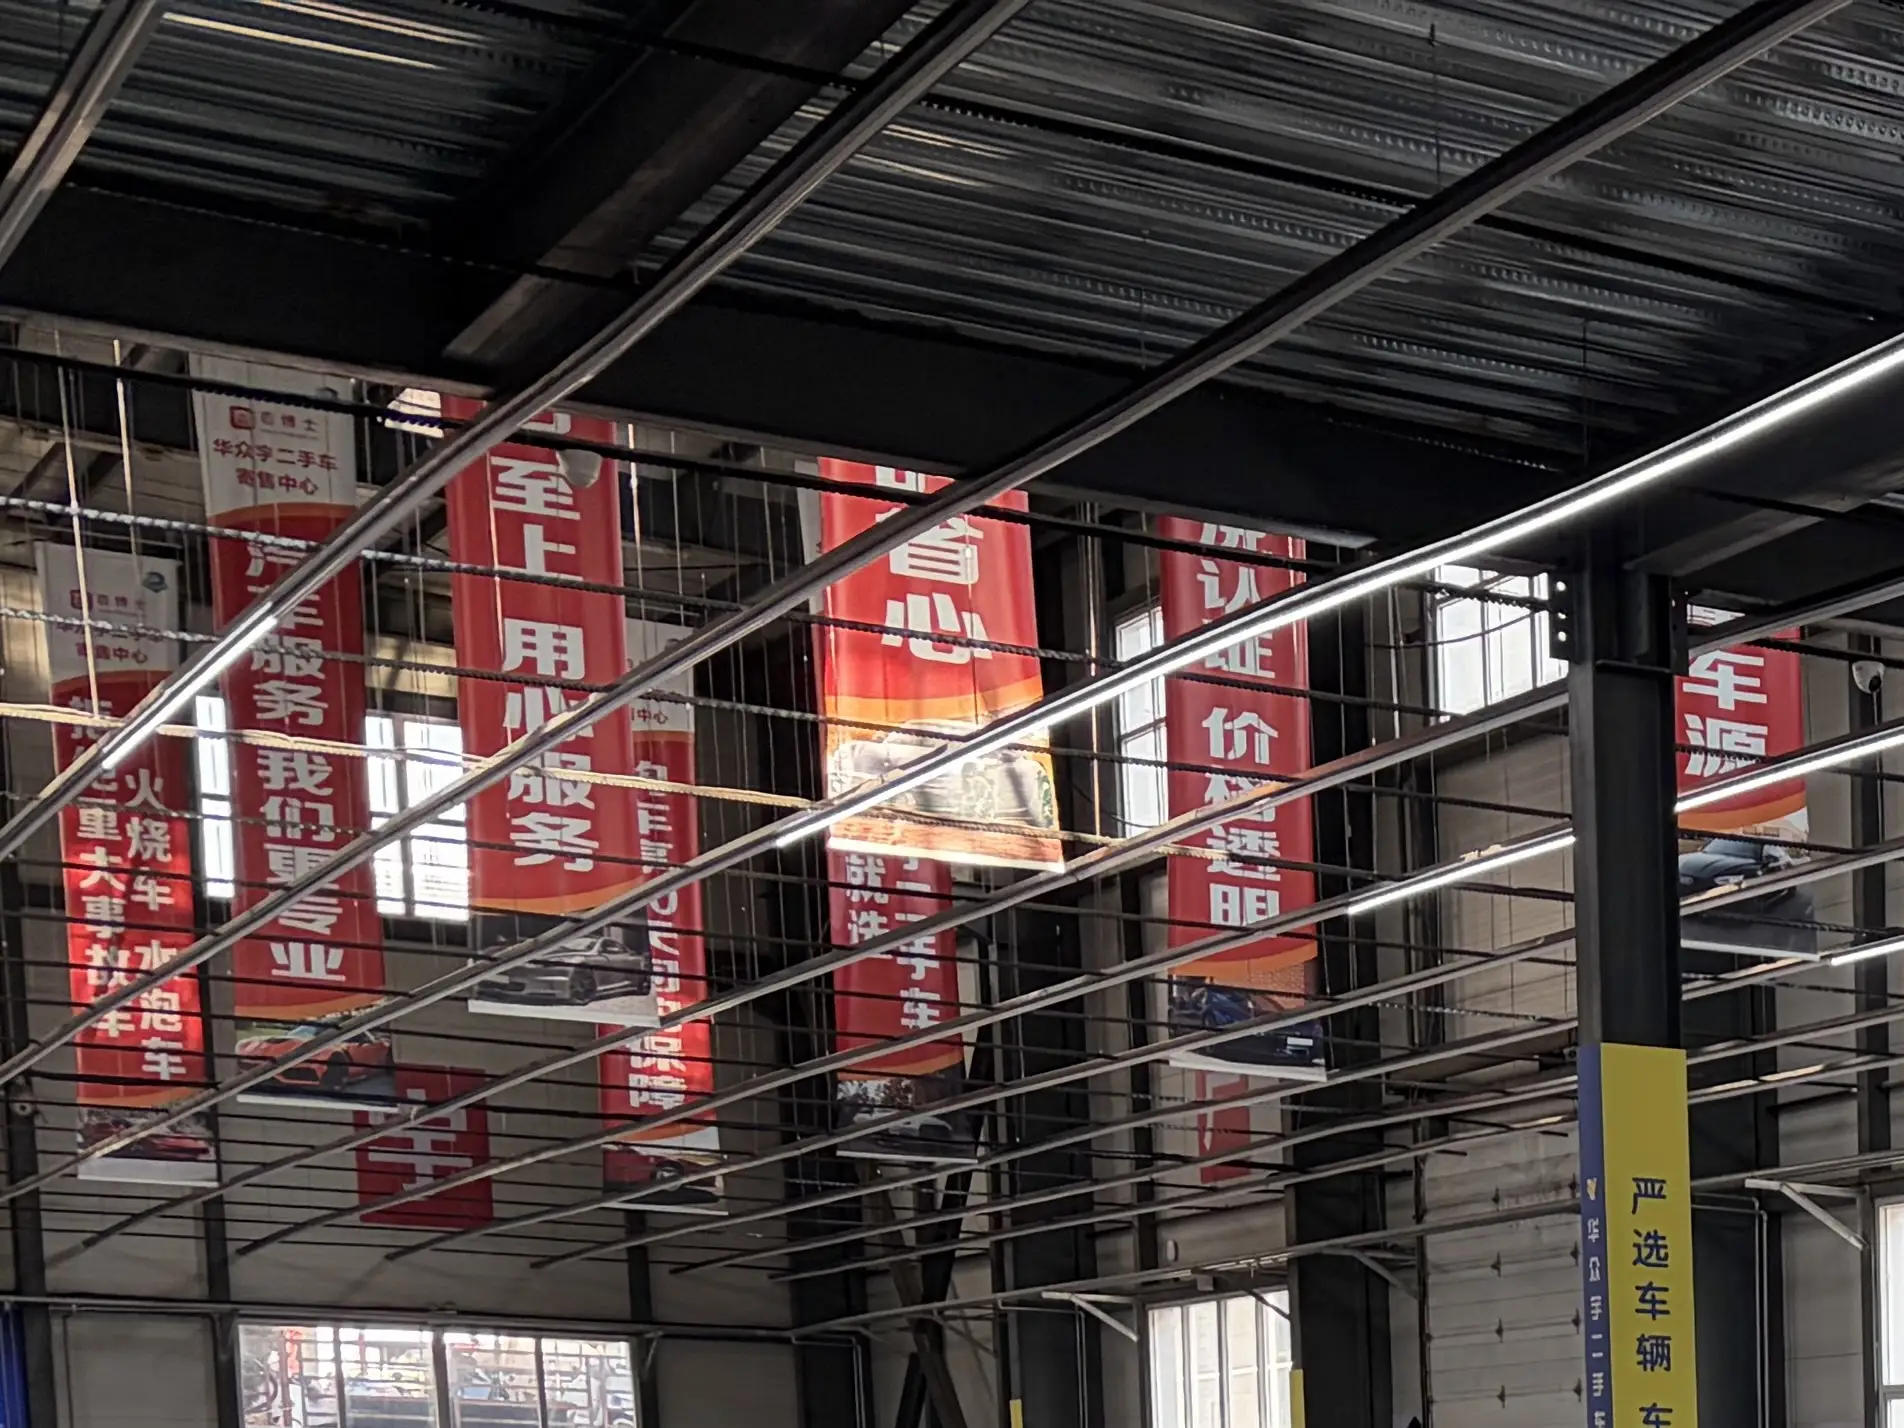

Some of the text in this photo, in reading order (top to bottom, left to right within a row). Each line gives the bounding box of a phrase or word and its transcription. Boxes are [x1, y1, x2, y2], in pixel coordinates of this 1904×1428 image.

[123, 767, 177, 913] 火烧车
[1631, 1176, 1673, 1373] 严选车辆
